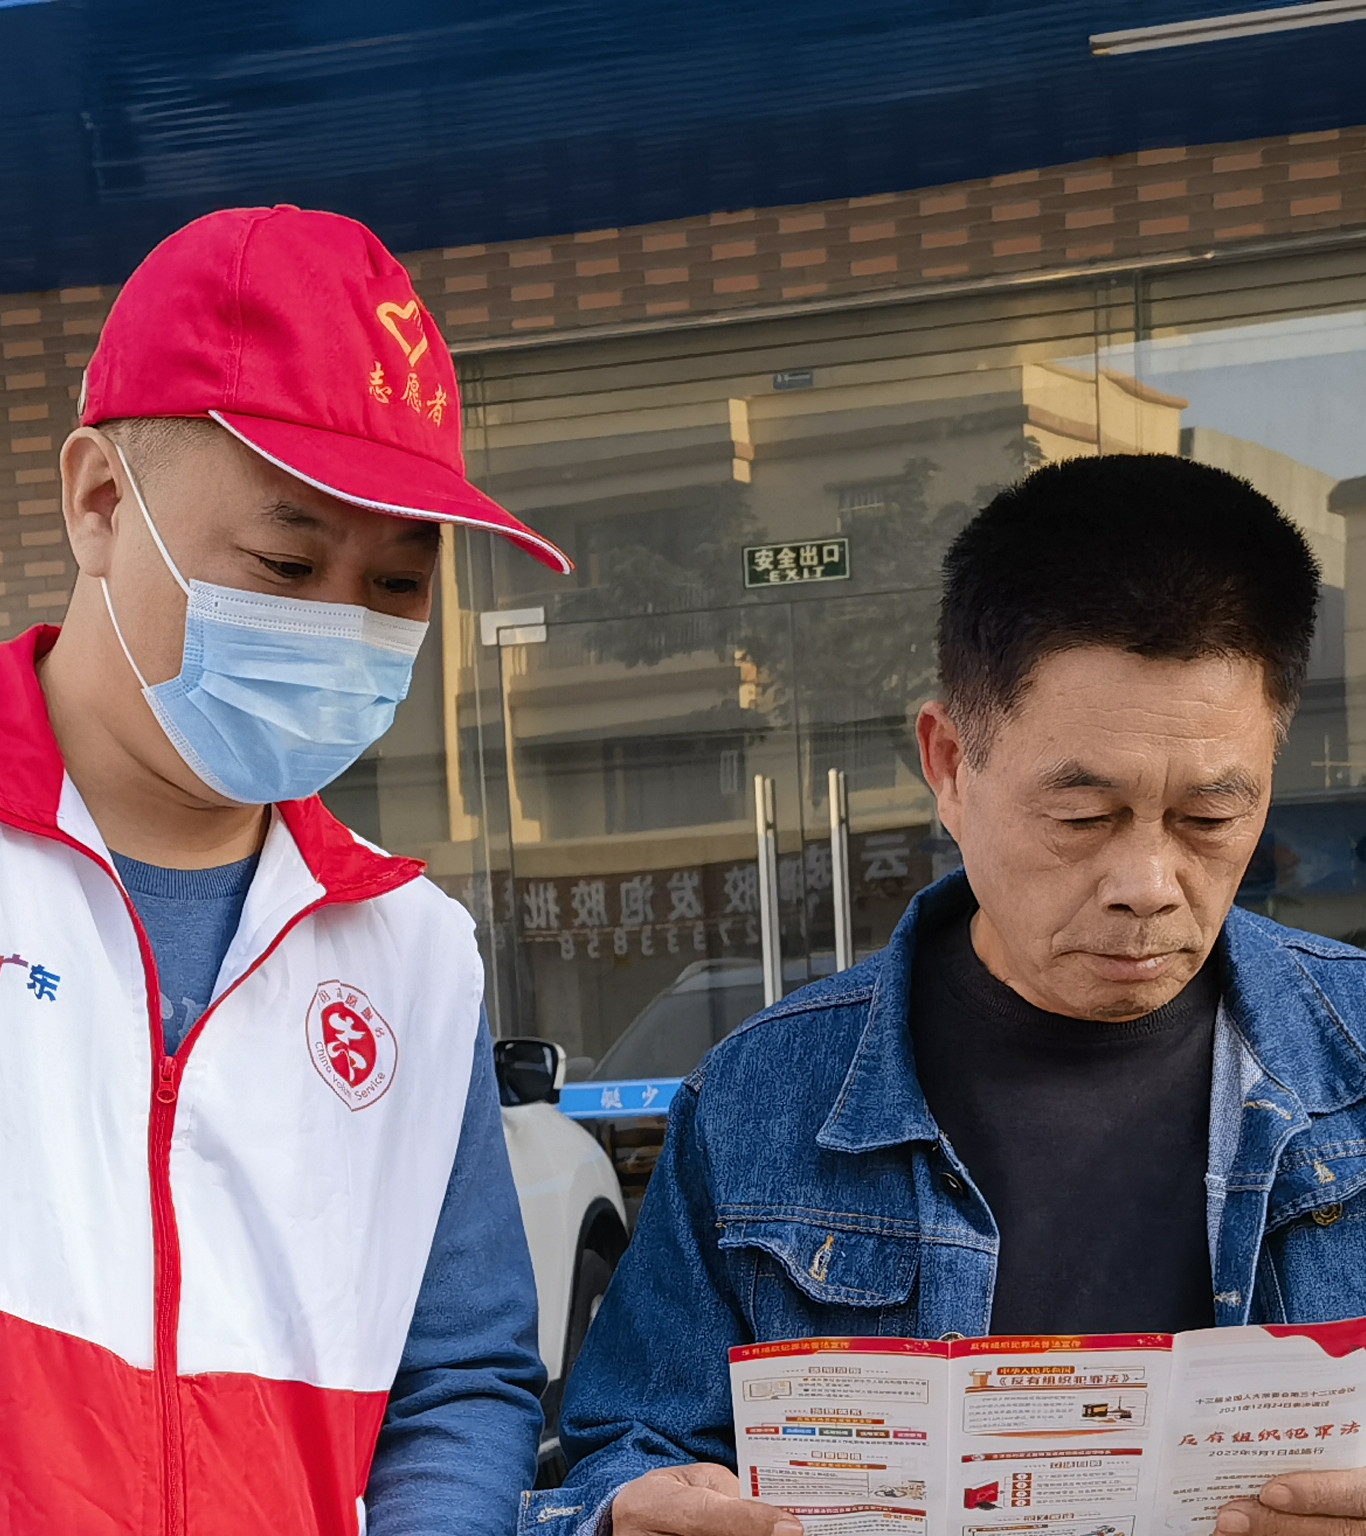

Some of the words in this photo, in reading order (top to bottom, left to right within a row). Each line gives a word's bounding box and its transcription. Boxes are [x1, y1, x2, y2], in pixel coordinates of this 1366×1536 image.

[368, 362, 448, 428] 志愿者
[753, 545, 839, 571] 安全出口
[769, 566, 825, 582] EXIT
[315, 1041, 332, 1073] China
[354, 1072, 386, 1101] Service
[1177, 1420, 1362, 1447] 反有组织犯罪法
